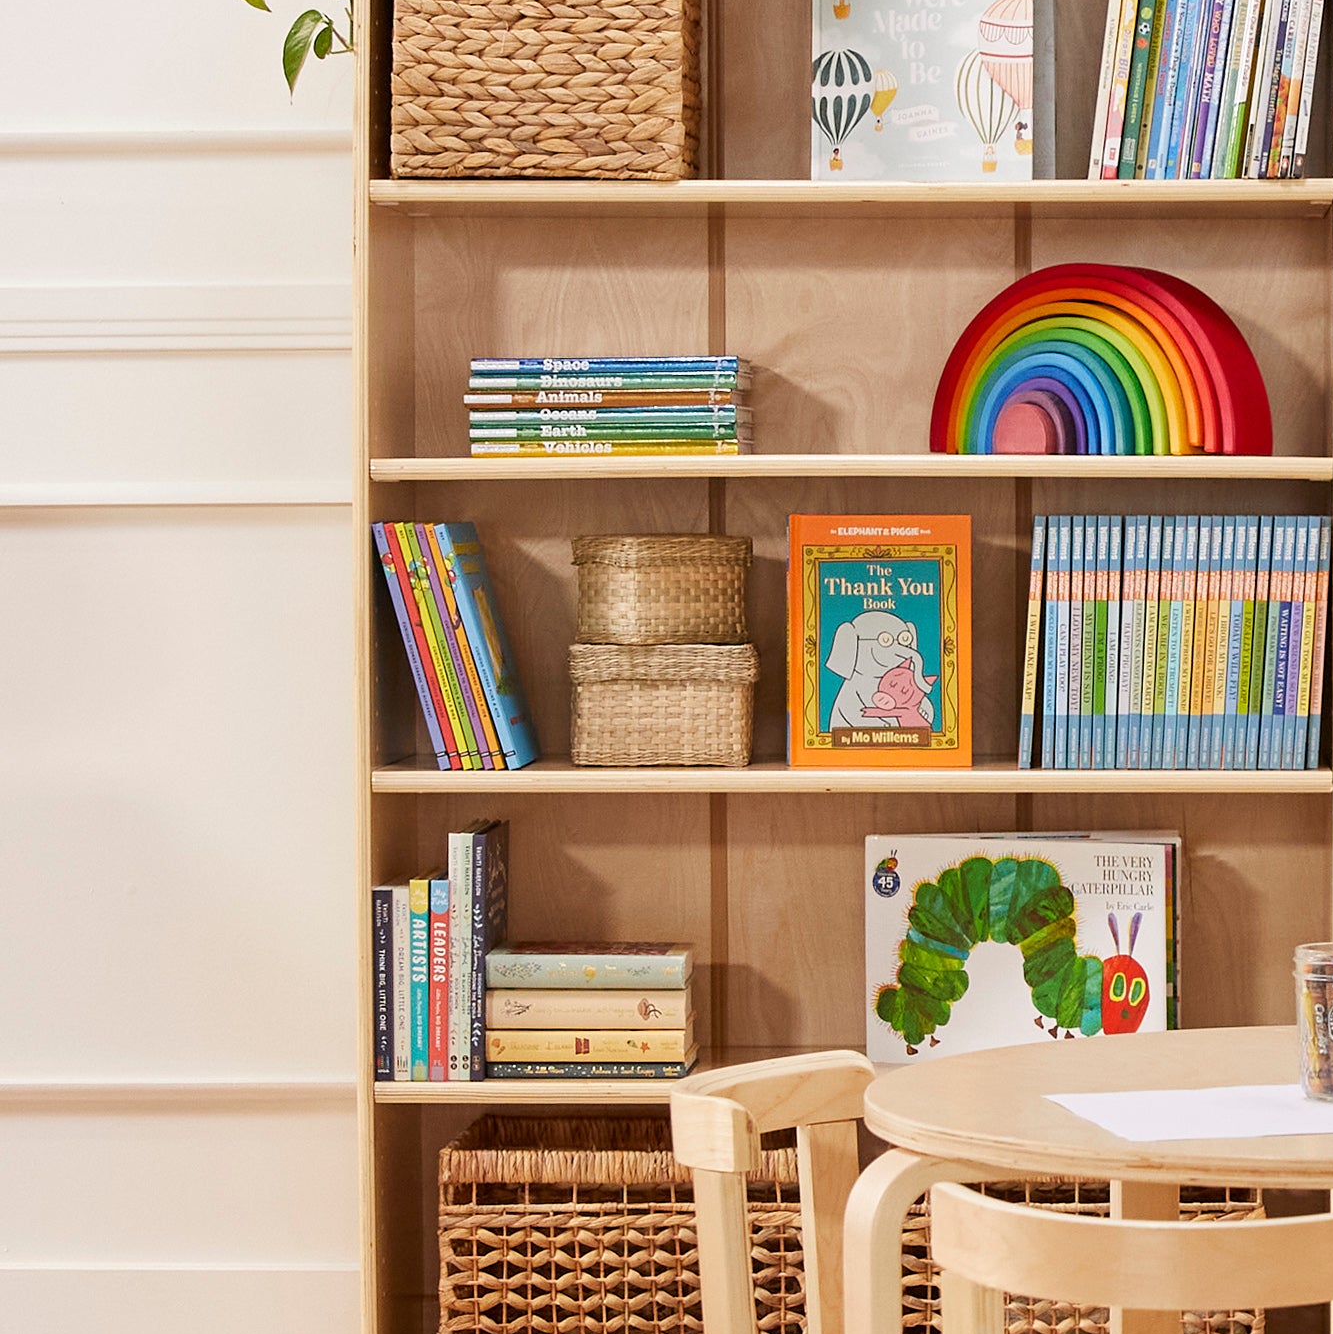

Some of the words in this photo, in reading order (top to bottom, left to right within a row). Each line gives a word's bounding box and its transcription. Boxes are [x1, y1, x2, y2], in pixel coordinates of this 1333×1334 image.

[872, 9, 943, 41] Made
[1211, 9, 1222, 33] WHO
[1284, 19, 1295, 58] CARROTS
[1206, 37, 1218, 68] LOVED
[910, 62, 943, 84] Be
[1117, 57, 1128, 78] BIG
[1201, 71, 1214, 103] MATH
[542, 359, 590, 373] Space
[540, 375, 623, 388] Dinosaurs
[535, 391, 603, 404] Animals
[540, 408, 597, 421] Oceans
[540, 424, 587, 437] Earth
[543, 441, 612, 454] Vehicles
[837, 527, 883, 536] ELEPHANT
[891, 527, 920, 535] PIGGIE
[866, 564, 893, 576] The
[824, 578, 893, 596] Thank
[897, 578, 934, 596] You
[863, 598, 896, 609] Book
[1084, 612, 1092, 623] MY
[1028, 620, 1036, 643] WILL
[1122, 622, 1130, 651] HAPPY
[1232, 613, 1240, 643] TODAY
[1279, 608, 1289, 647] WAITING
[1071, 643, 1079, 657] MY
[1083, 631, 1091, 667] FRIEND
[1108, 636, 1116, 650] AM
[1026, 644, 1034, 668] TAKE
[1278, 649, 1286, 658] IS
[1230, 651, 1238, 676] WILL
[1277, 660, 1285, 678] NOT
[1083, 671, 1090, 681] IS
[1121, 671, 1129, 692] DAY!
[1024, 678, 1032, 699] NAP!
[1229, 679, 1237, 699] FLY!
[1275, 681, 1284, 707] EASY!
[1070, 688, 1078, 710] TOY!
[852, 731, 870, 743] Mo
[872, 731, 919, 743] Willems
[1094, 855, 1120, 867] THE
[1122, 856, 1154, 868] VERY
[878, 876, 894, 888] 45
[1103, 870, 1154, 882] HUNGRY
[1070, 883, 1154, 896] CATERPILLAR
[1105, 901, 1114, 911] by
[1117, 901, 1132, 910] Eric
[1133, 902, 1154, 911] Carle
[411, 918, 427, 982] ARTISTS
[432, 922, 446, 982] LEADERS
[378, 989, 386, 1011] LITTLE
[378, 1014, 386, 1030] ONE
